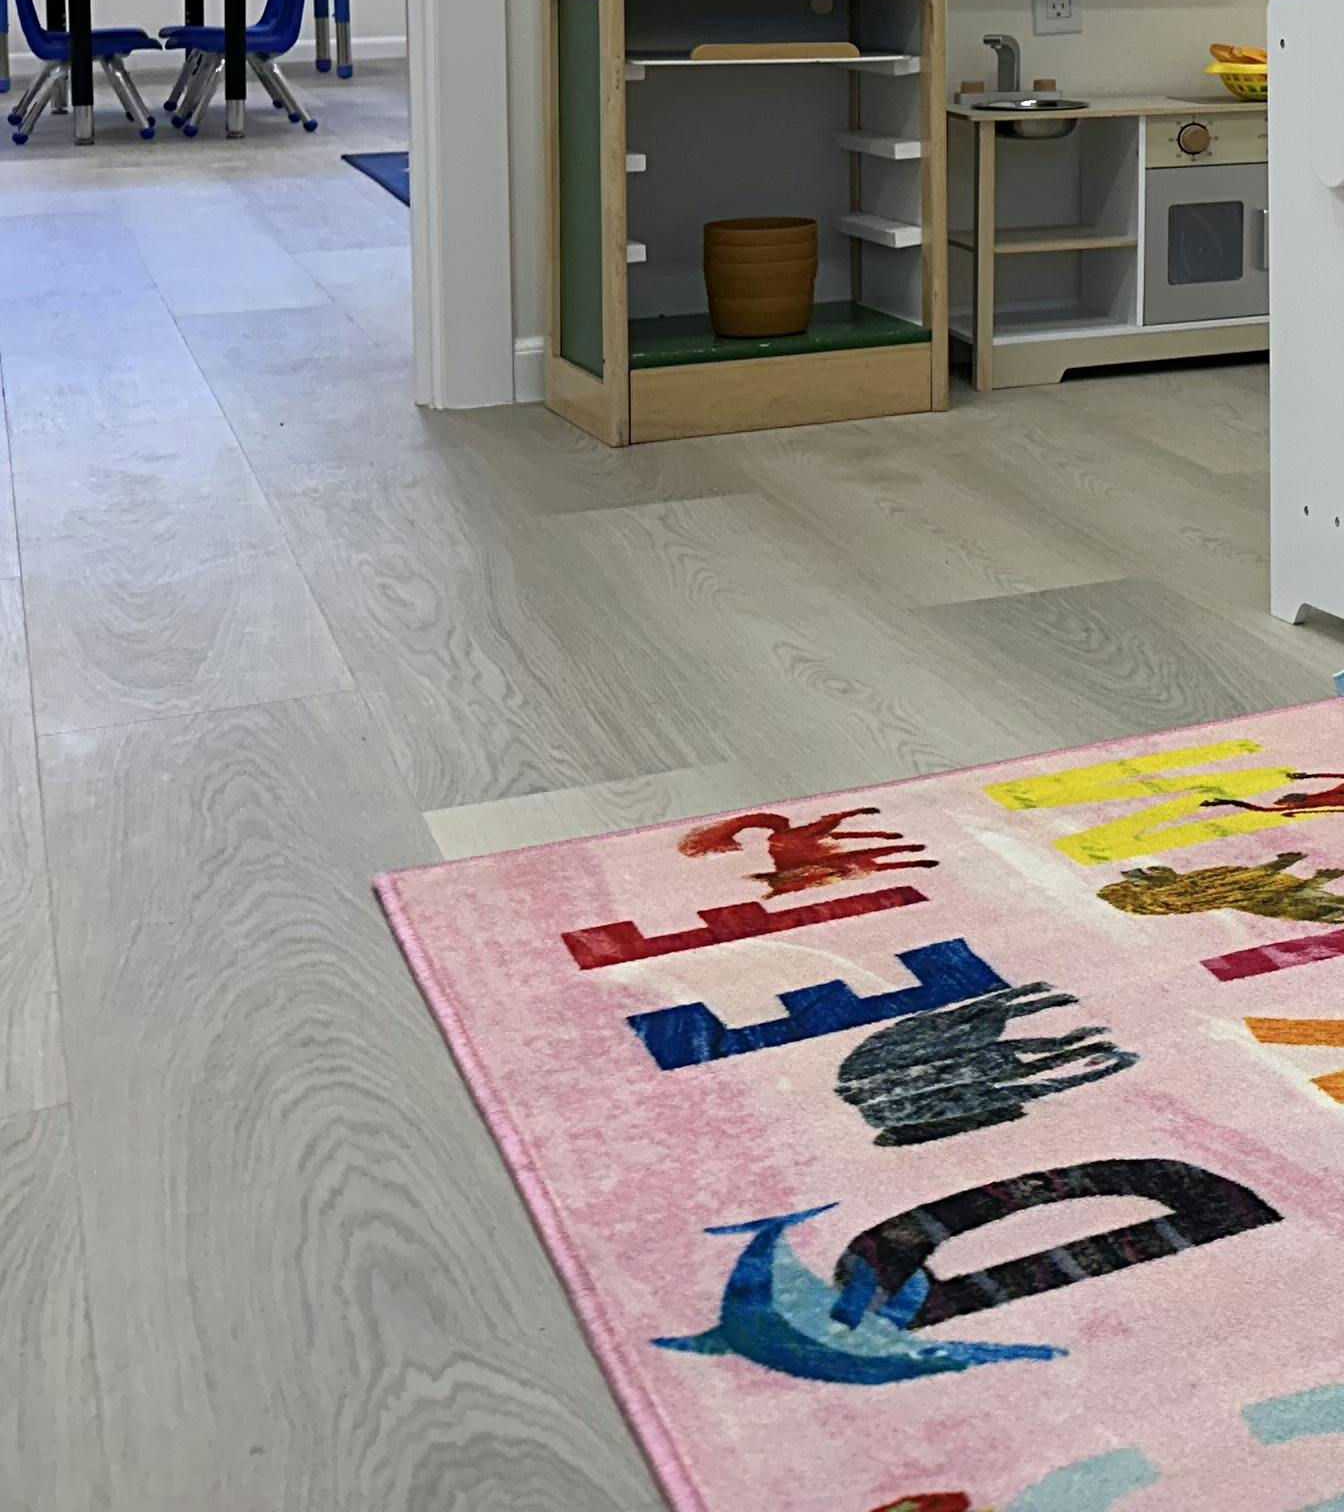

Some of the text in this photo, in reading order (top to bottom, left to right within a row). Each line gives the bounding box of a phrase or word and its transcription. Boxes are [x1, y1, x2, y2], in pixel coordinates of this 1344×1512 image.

[561, 885, 930, 970] F
[626, 938, 1012, 1071] E
[833, 1159, 1285, 1332] D
